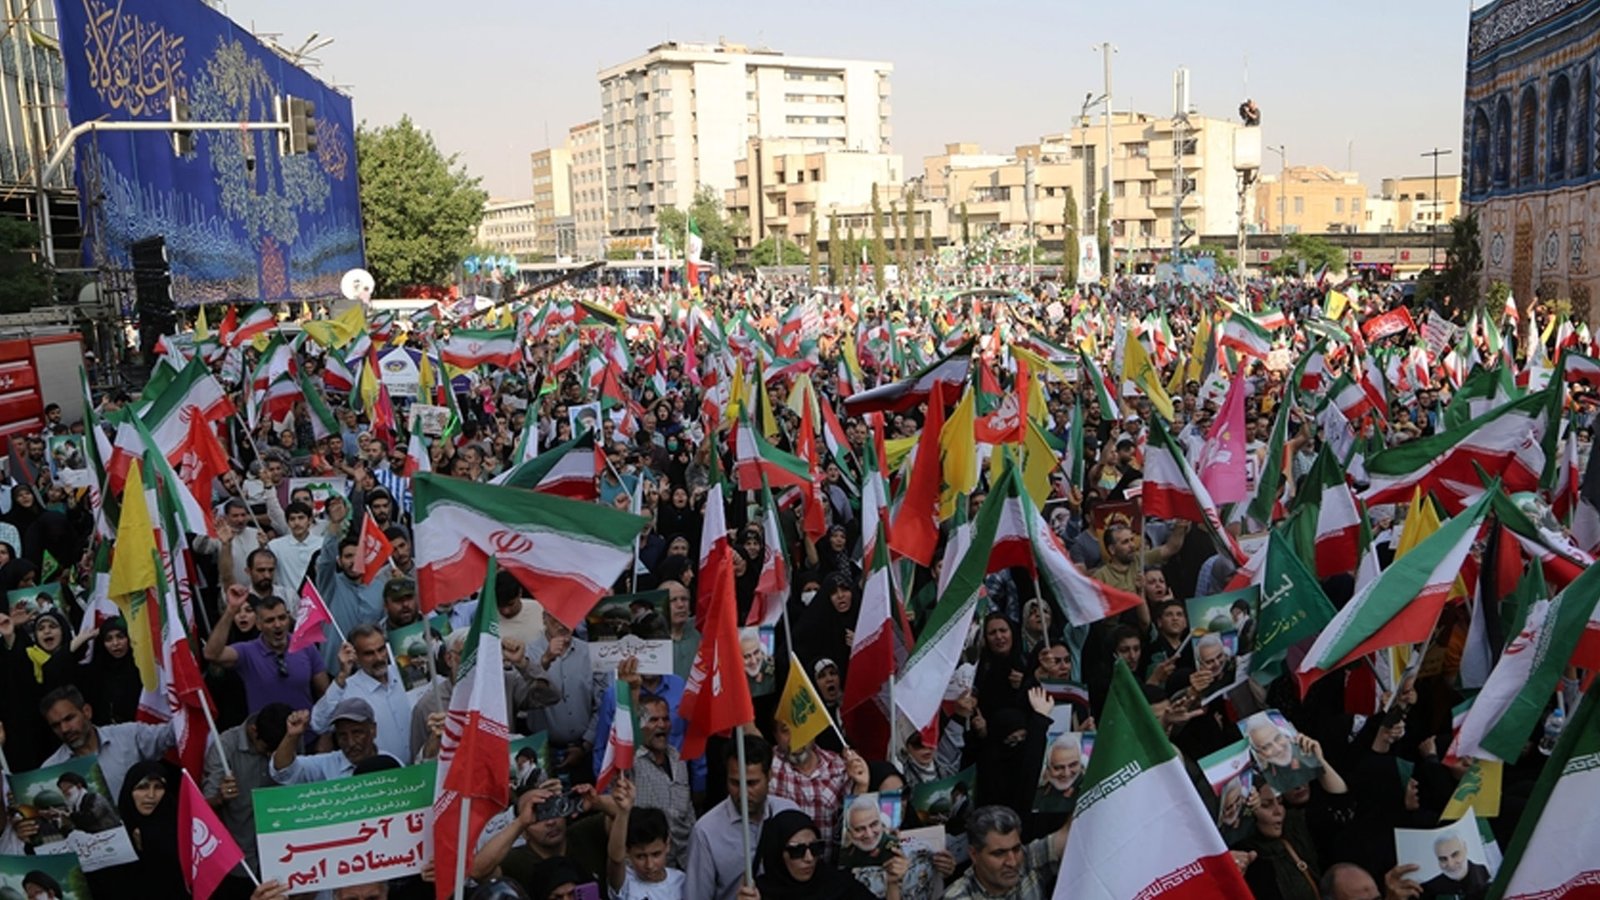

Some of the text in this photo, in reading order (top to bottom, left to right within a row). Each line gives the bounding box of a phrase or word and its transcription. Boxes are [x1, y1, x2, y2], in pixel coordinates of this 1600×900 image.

[279, 813, 425, 863] تا آخر
[287, 841, 423, 889] ایستاده ایم
